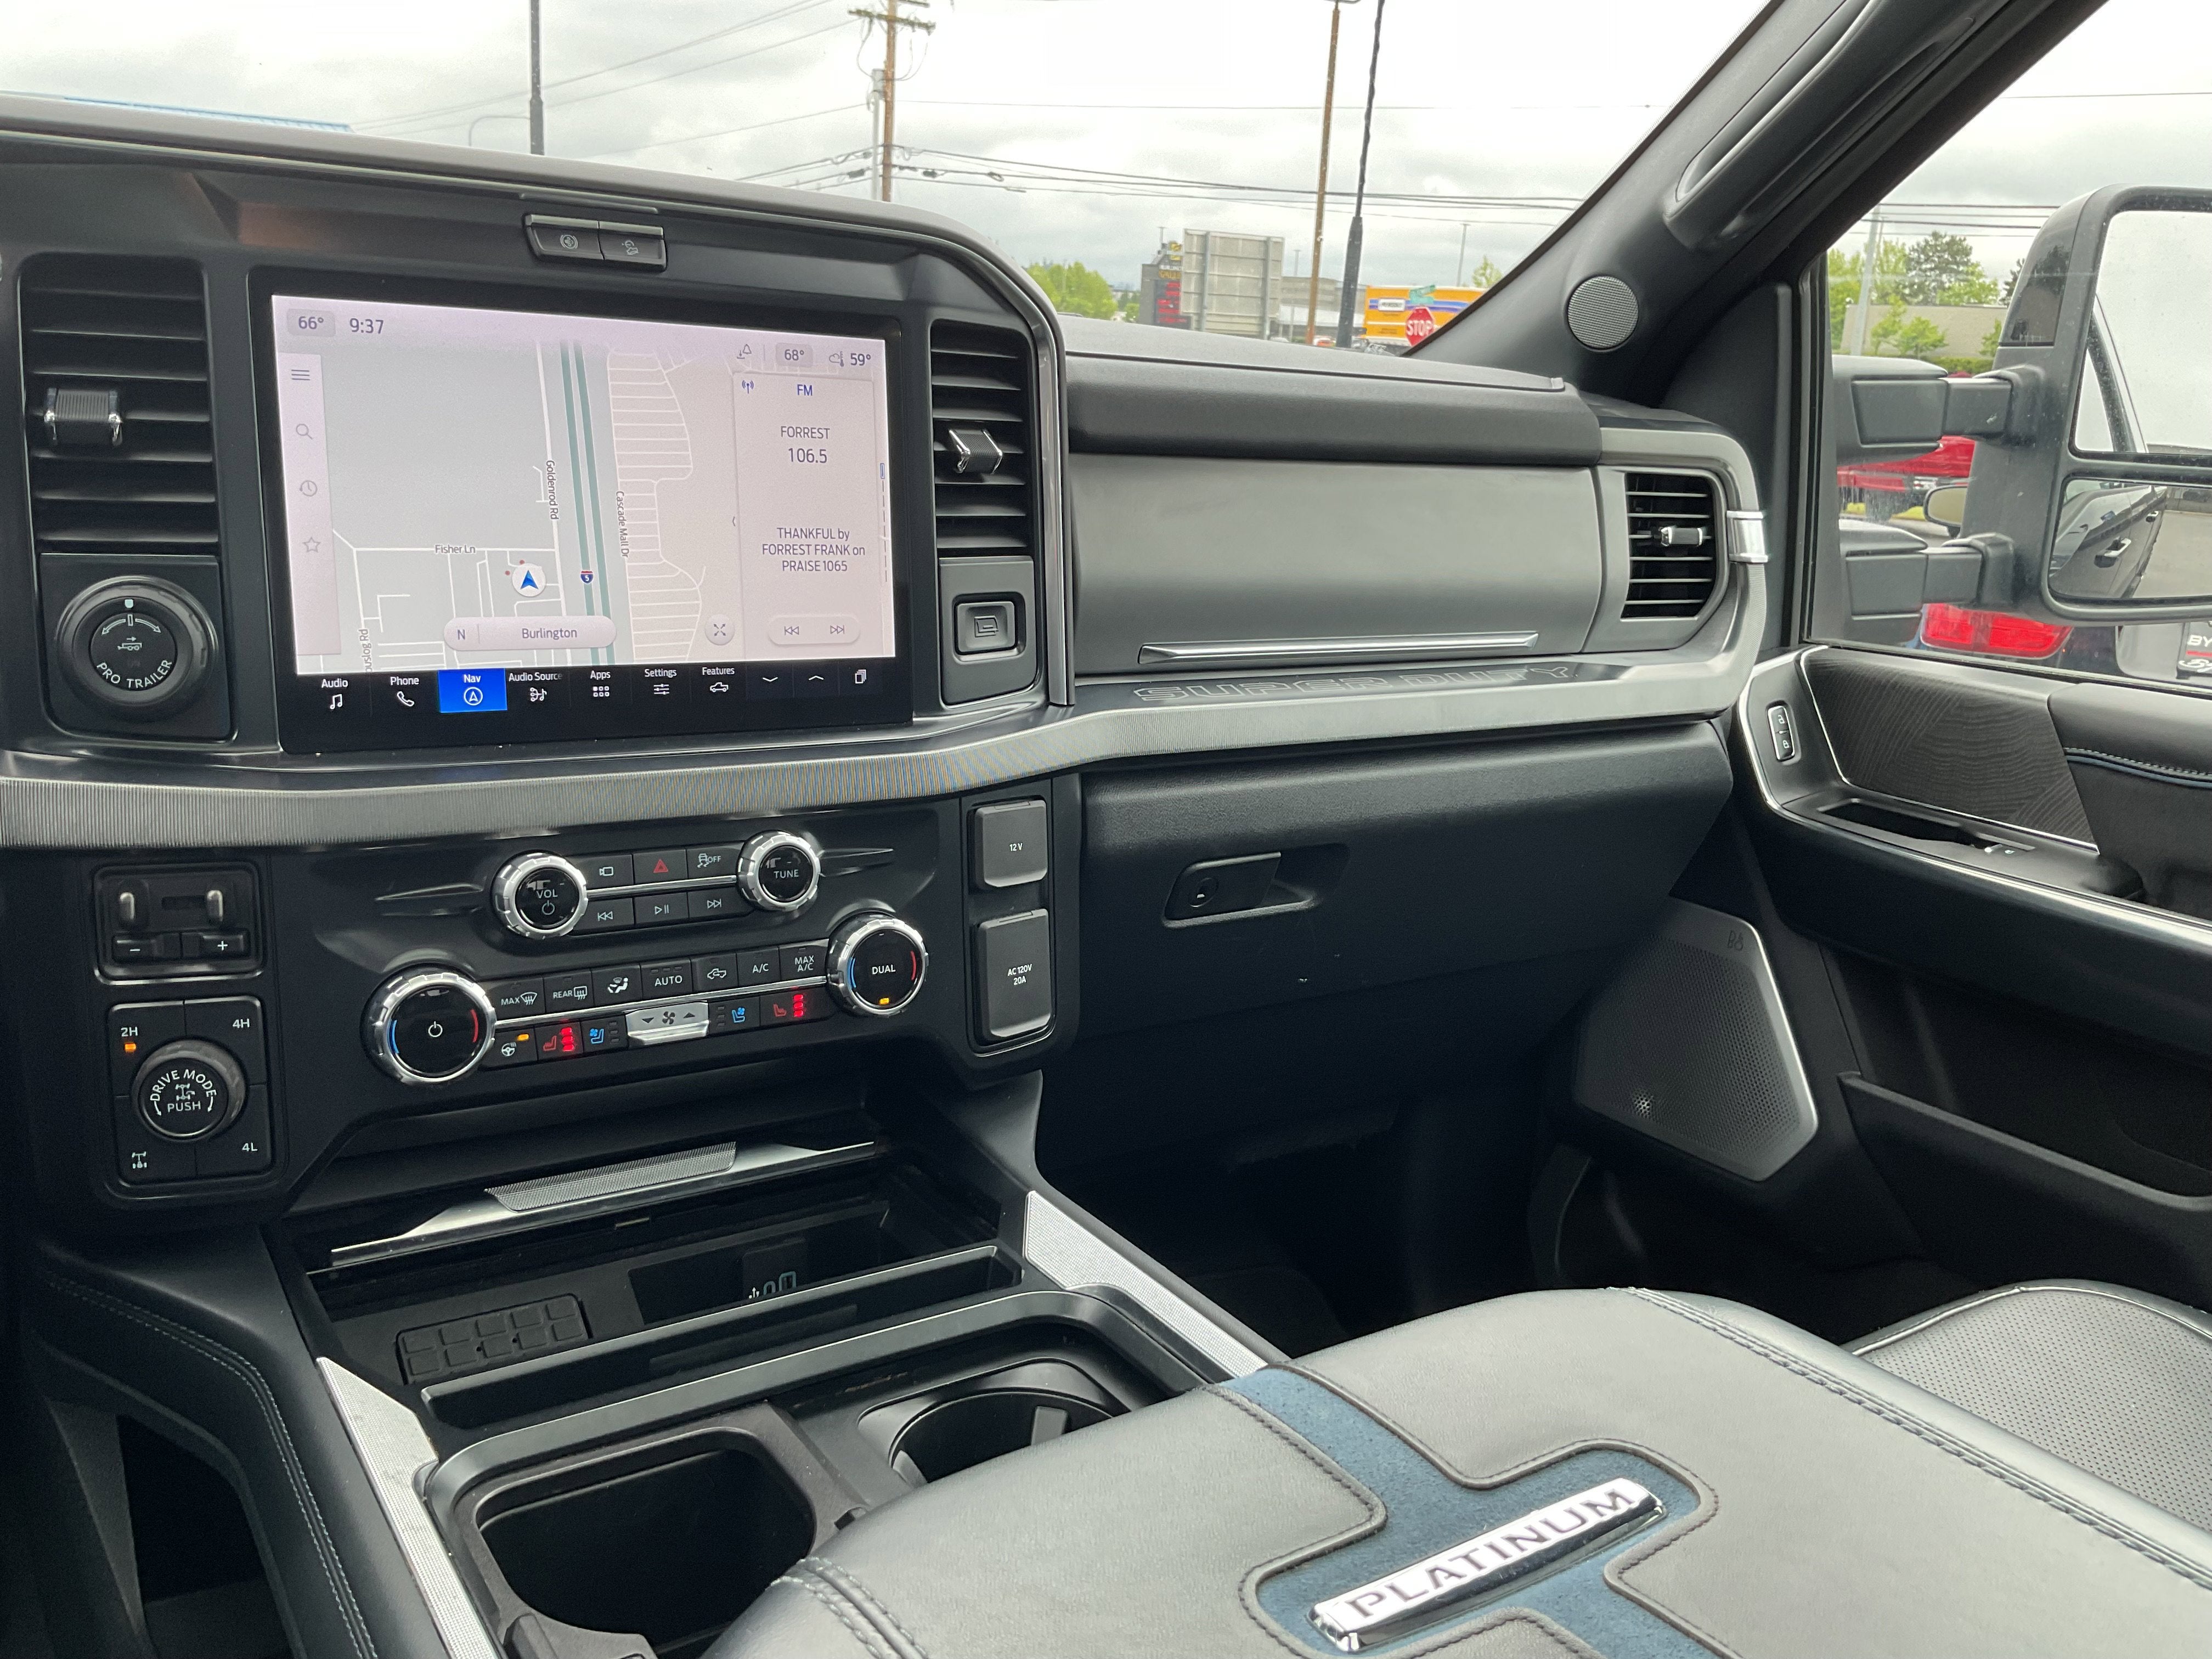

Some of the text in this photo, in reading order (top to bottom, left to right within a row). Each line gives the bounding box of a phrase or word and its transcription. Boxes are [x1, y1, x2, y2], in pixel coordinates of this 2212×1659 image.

[298, 316, 324, 330] 66°
[349, 318, 384, 334] 9:37
[1406, 320, 1432, 336] STOP
[784, 349, 805, 361] 68°
[850, 353, 871, 366] 59°
[797, 384, 813, 396] FM
[780, 426, 831, 439] FORREST
[788, 448, 828, 464] 106.5
[546, 460, 559, 520] Goldenrod Rd
[616, 491, 630, 558] Cascade Mall Dr
[776, 527, 850, 541] THANKFUL by
[435, 544, 476, 554] Fisher Ln
[762, 544, 865, 556] FORREST FRANK on
[782, 560, 848, 572] PRAISE 1065
[358, 629, 369, 641] Rd
[457, 629, 466, 640] N
[522, 628, 578, 641] Burlington
[96, 659, 173, 689] PRO TRAILER
[590, 670, 611, 680] Apps
[644, 668, 678, 679] Settings
[702, 665, 735, 676] Features
[390, 676, 420, 686] Phone
[464, 674, 481, 683] Nav
[509, 672, 563, 682] Audio Source
[321, 678, 349, 689] Audio
[1133, 666, 1569, 701] SUPER DUTY
[1009, 843, 1017, 851] 12
[707, 855, 721, 864] OFF
[773, 869, 799, 879] TUNE
[535, 889, 558, 900] VOL
[794, 955, 815, 965] MAX
[752, 963, 769, 973] A/C
[797, 962, 814, 972] A/C
[871, 964, 896, 974] DUAL
[1007, 963, 1033, 977] AC 120V
[654, 975, 683, 986] AUTO
[1013, 975, 1027, 985] 20A
[552, 990, 573, 999] REAR
[500, 997, 521, 1006] MAX
[232, 1018, 250, 1029] 4H
[121, 1026, 138, 1037] 2H
[150, 1069, 217, 1102] DRIVE MODE
[167, 1101, 201, 1113] PUSH
[241, 1142, 258, 1152] 4L
[1344, 1487, 1635, 1618] PLATINUM
